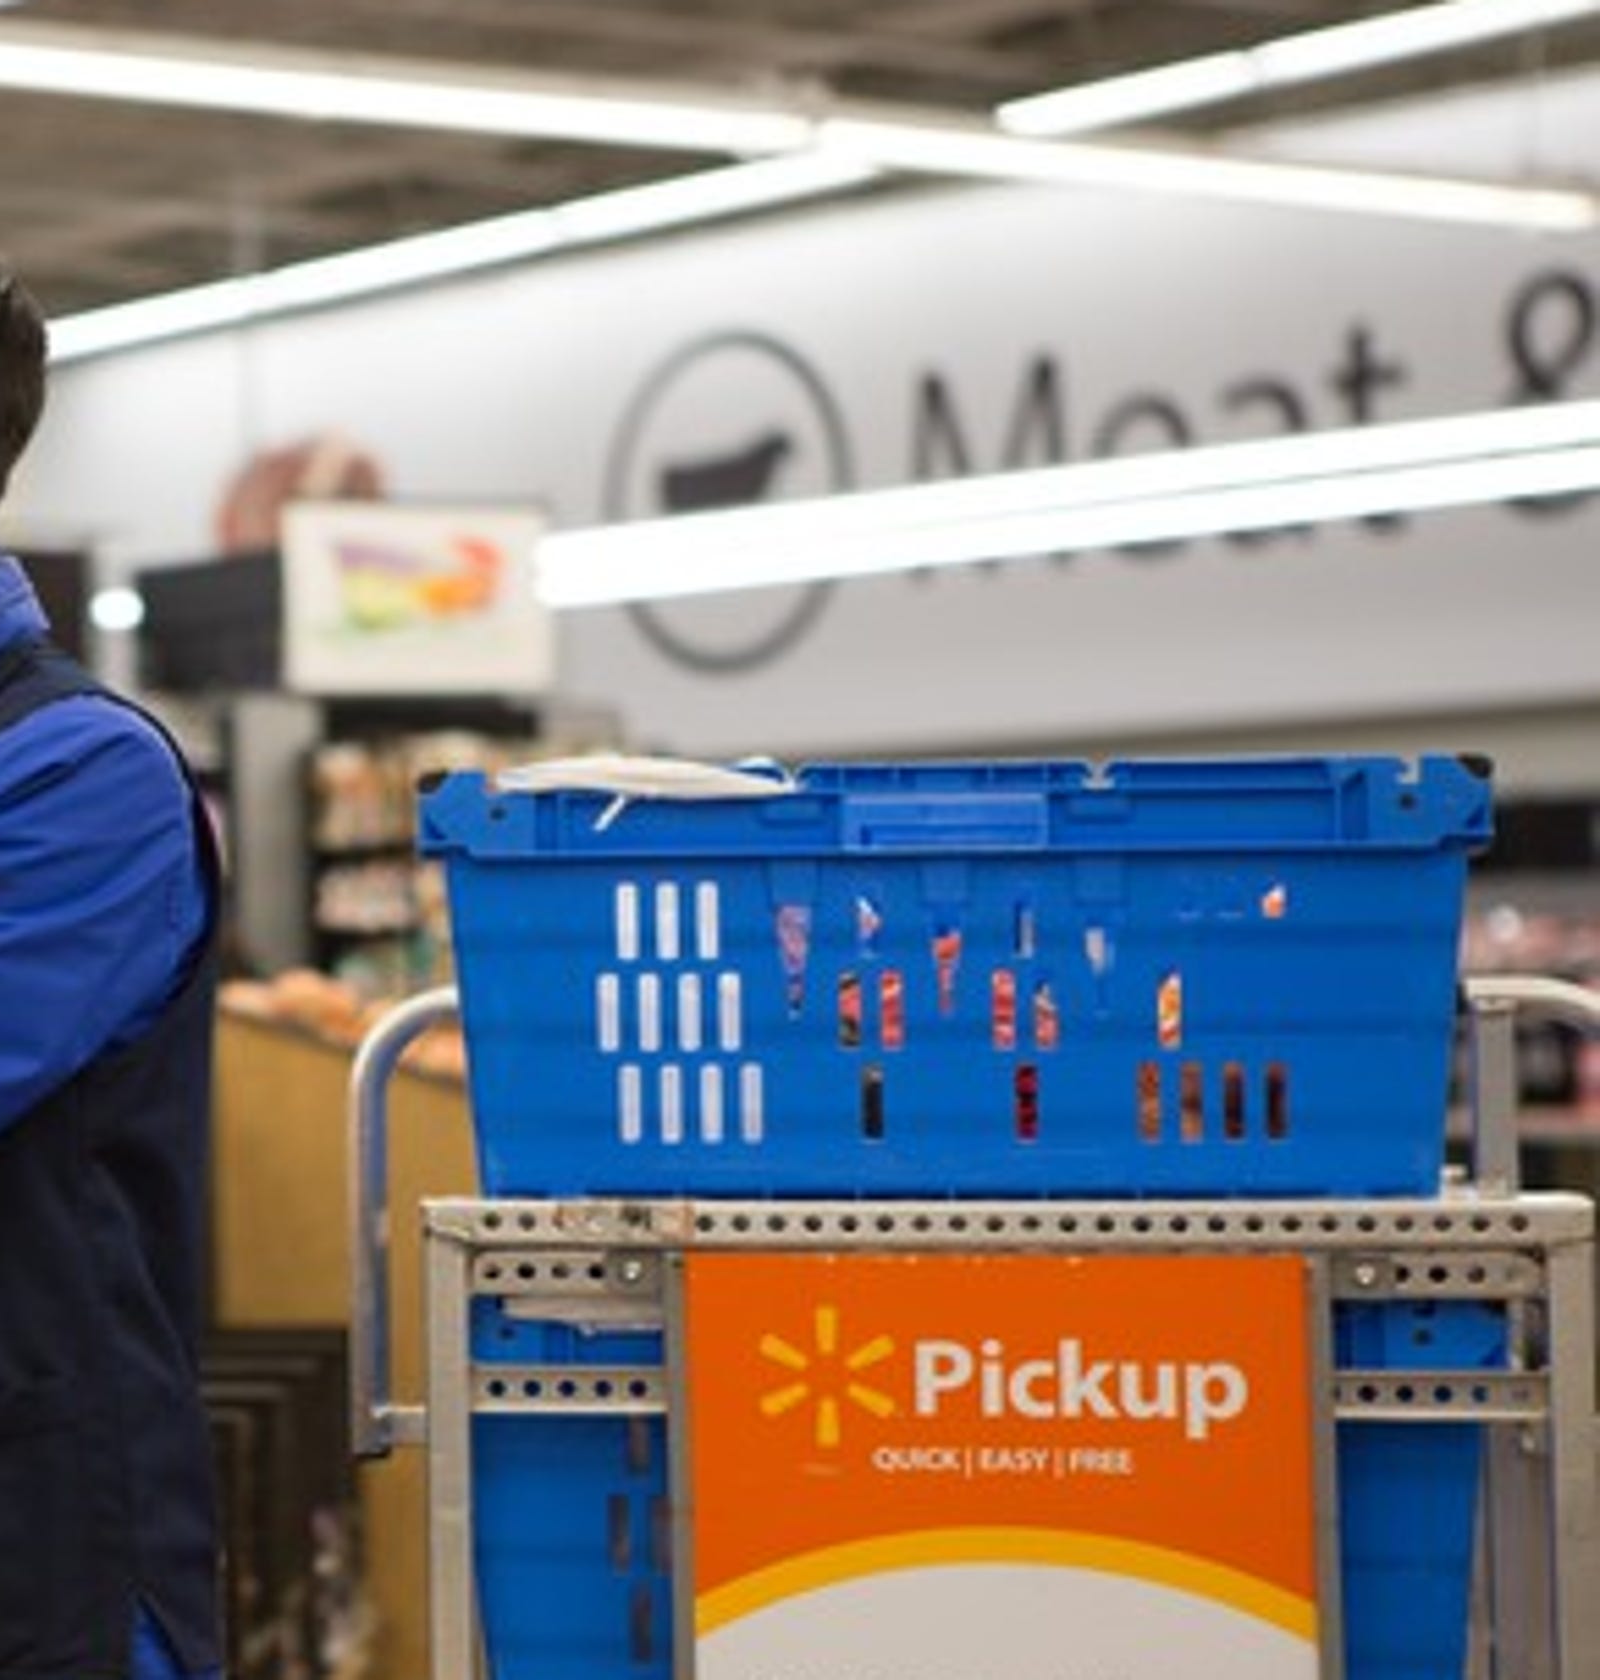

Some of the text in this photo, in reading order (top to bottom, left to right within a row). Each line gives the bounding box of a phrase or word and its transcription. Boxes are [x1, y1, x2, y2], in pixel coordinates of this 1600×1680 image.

[914, 1338, 1248, 1440] Pickup
[871, 1447, 1132, 1475] QUICK EASY FREE
